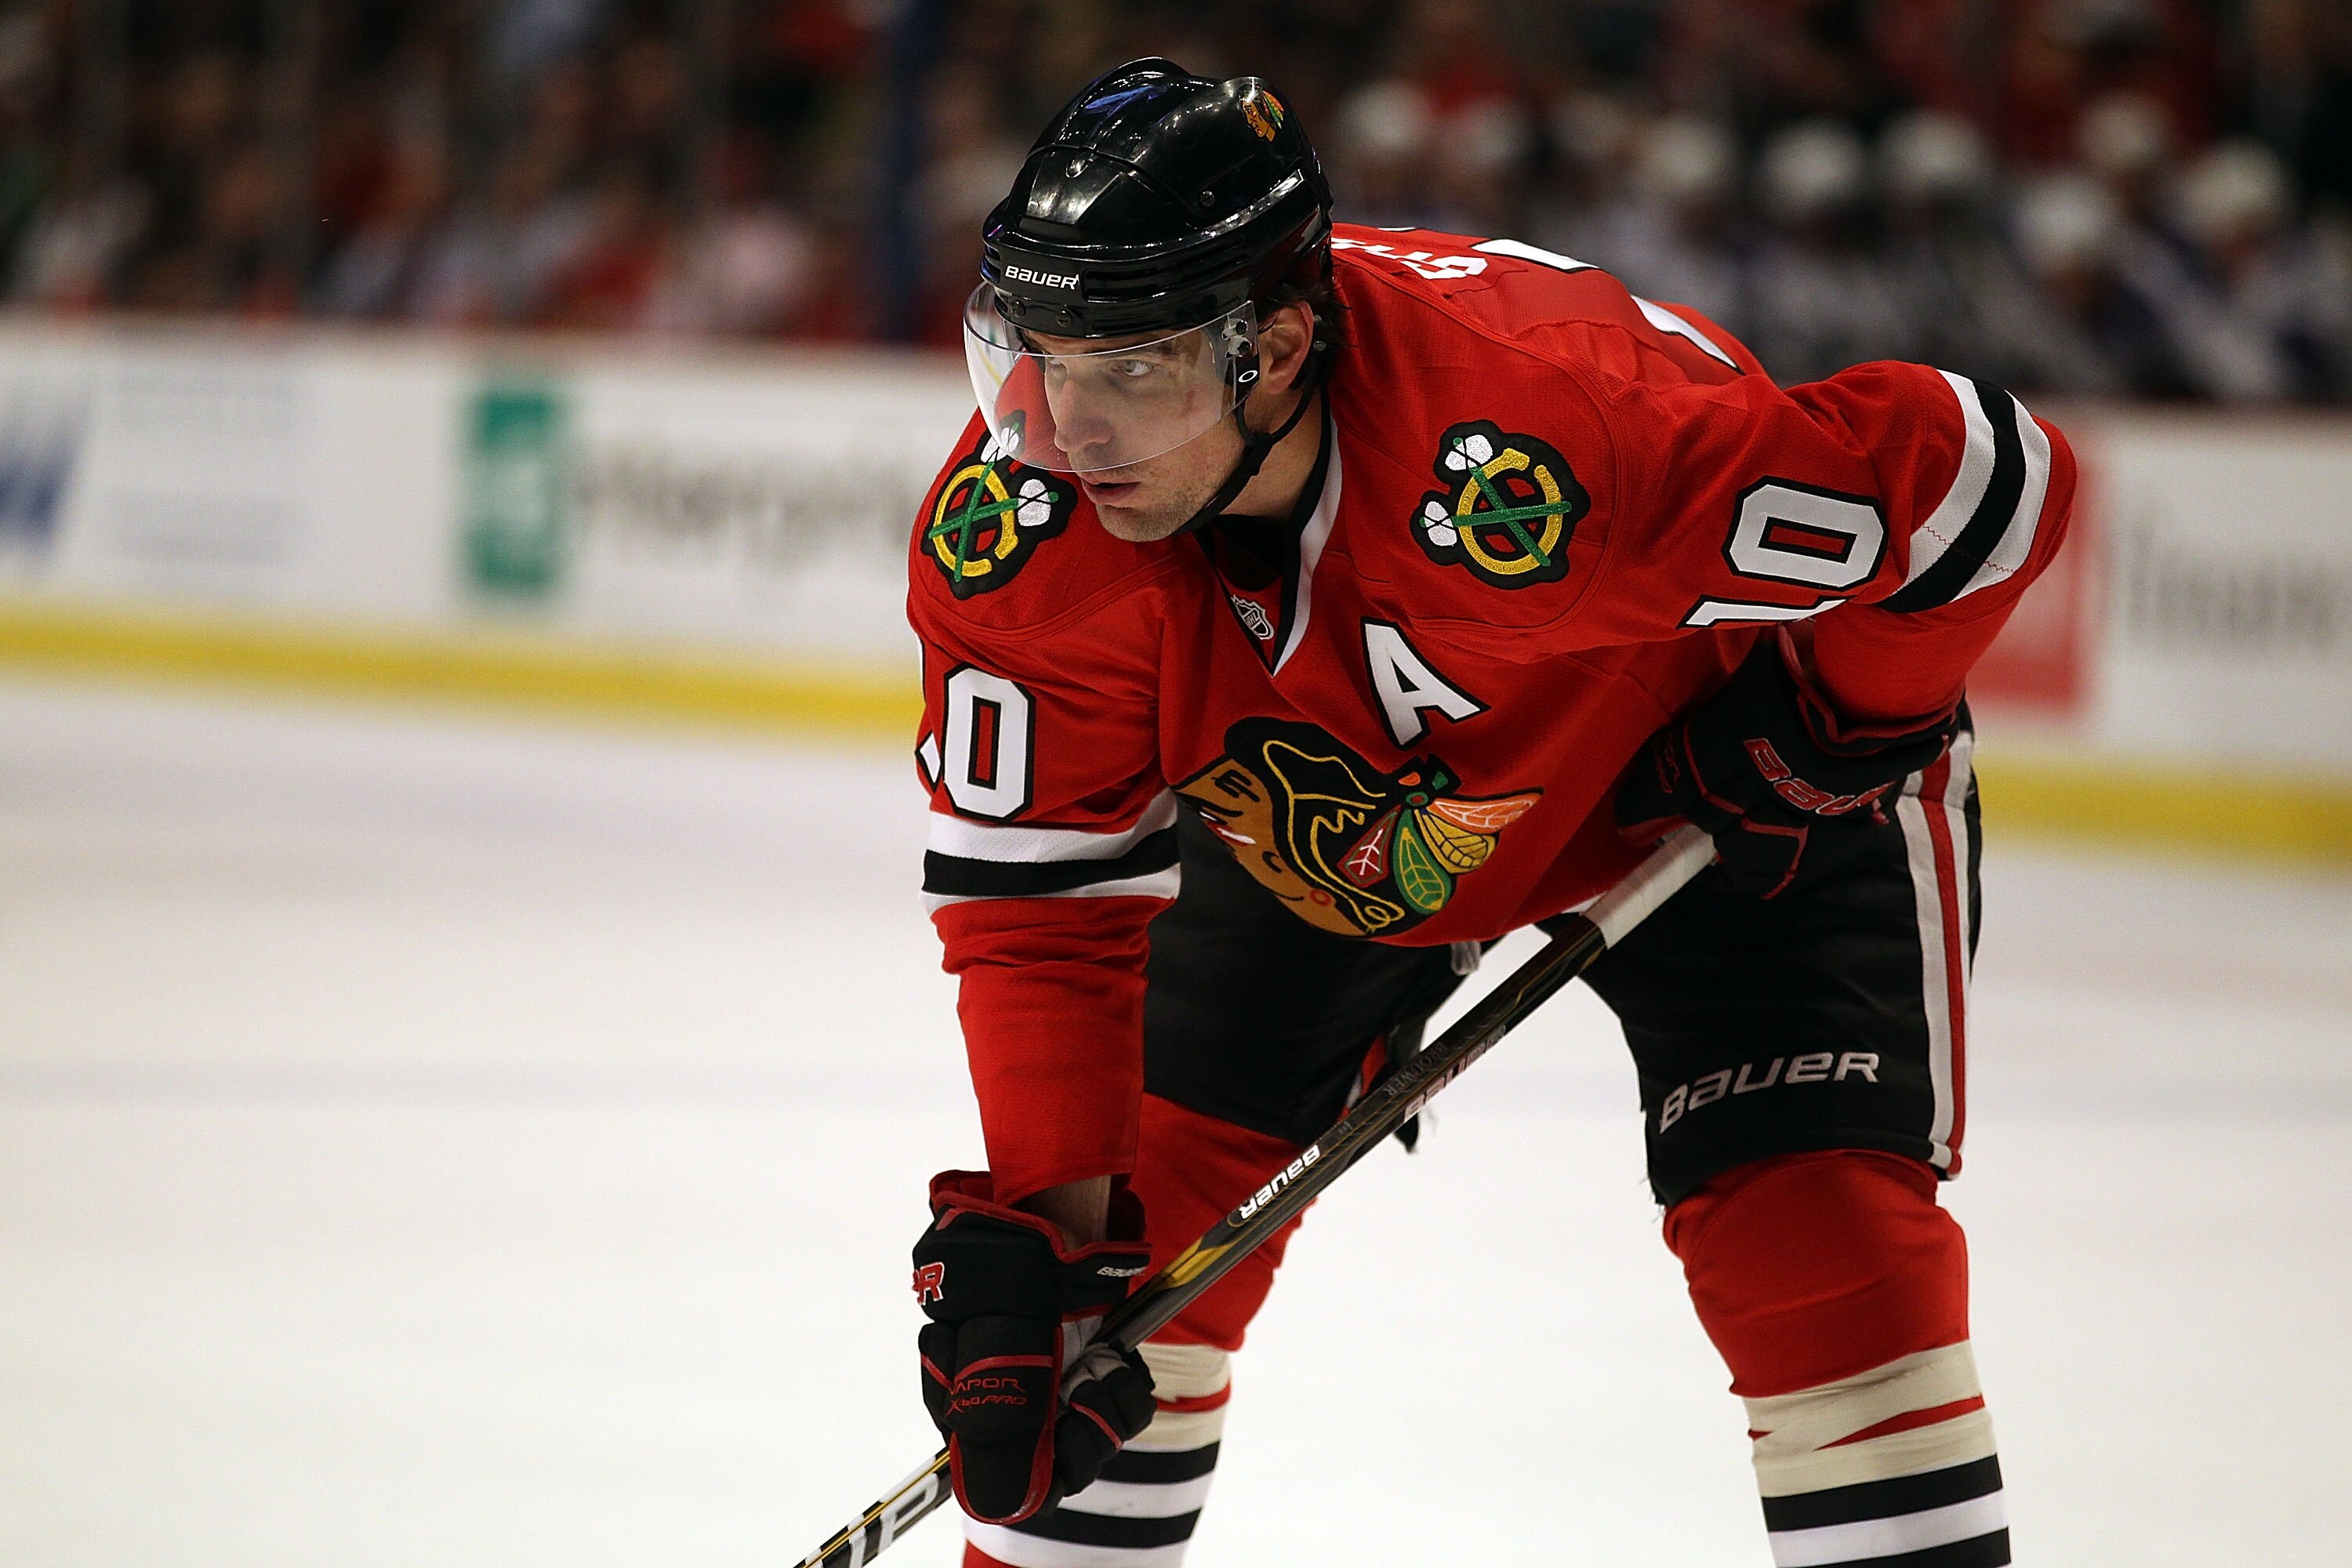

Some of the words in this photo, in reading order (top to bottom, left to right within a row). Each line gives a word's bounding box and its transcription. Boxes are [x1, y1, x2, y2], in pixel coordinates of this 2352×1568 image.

[1005, 265, 1078, 290] BAUER
[1361, 617, 1490, 750] A
[915, 662, 1035, 822] 0
[1658, 1052, 1879, 1134] BAUER
[1239, 1144, 1320, 1219] BAUER
[949, 1377, 1025, 1396] VAPOR
